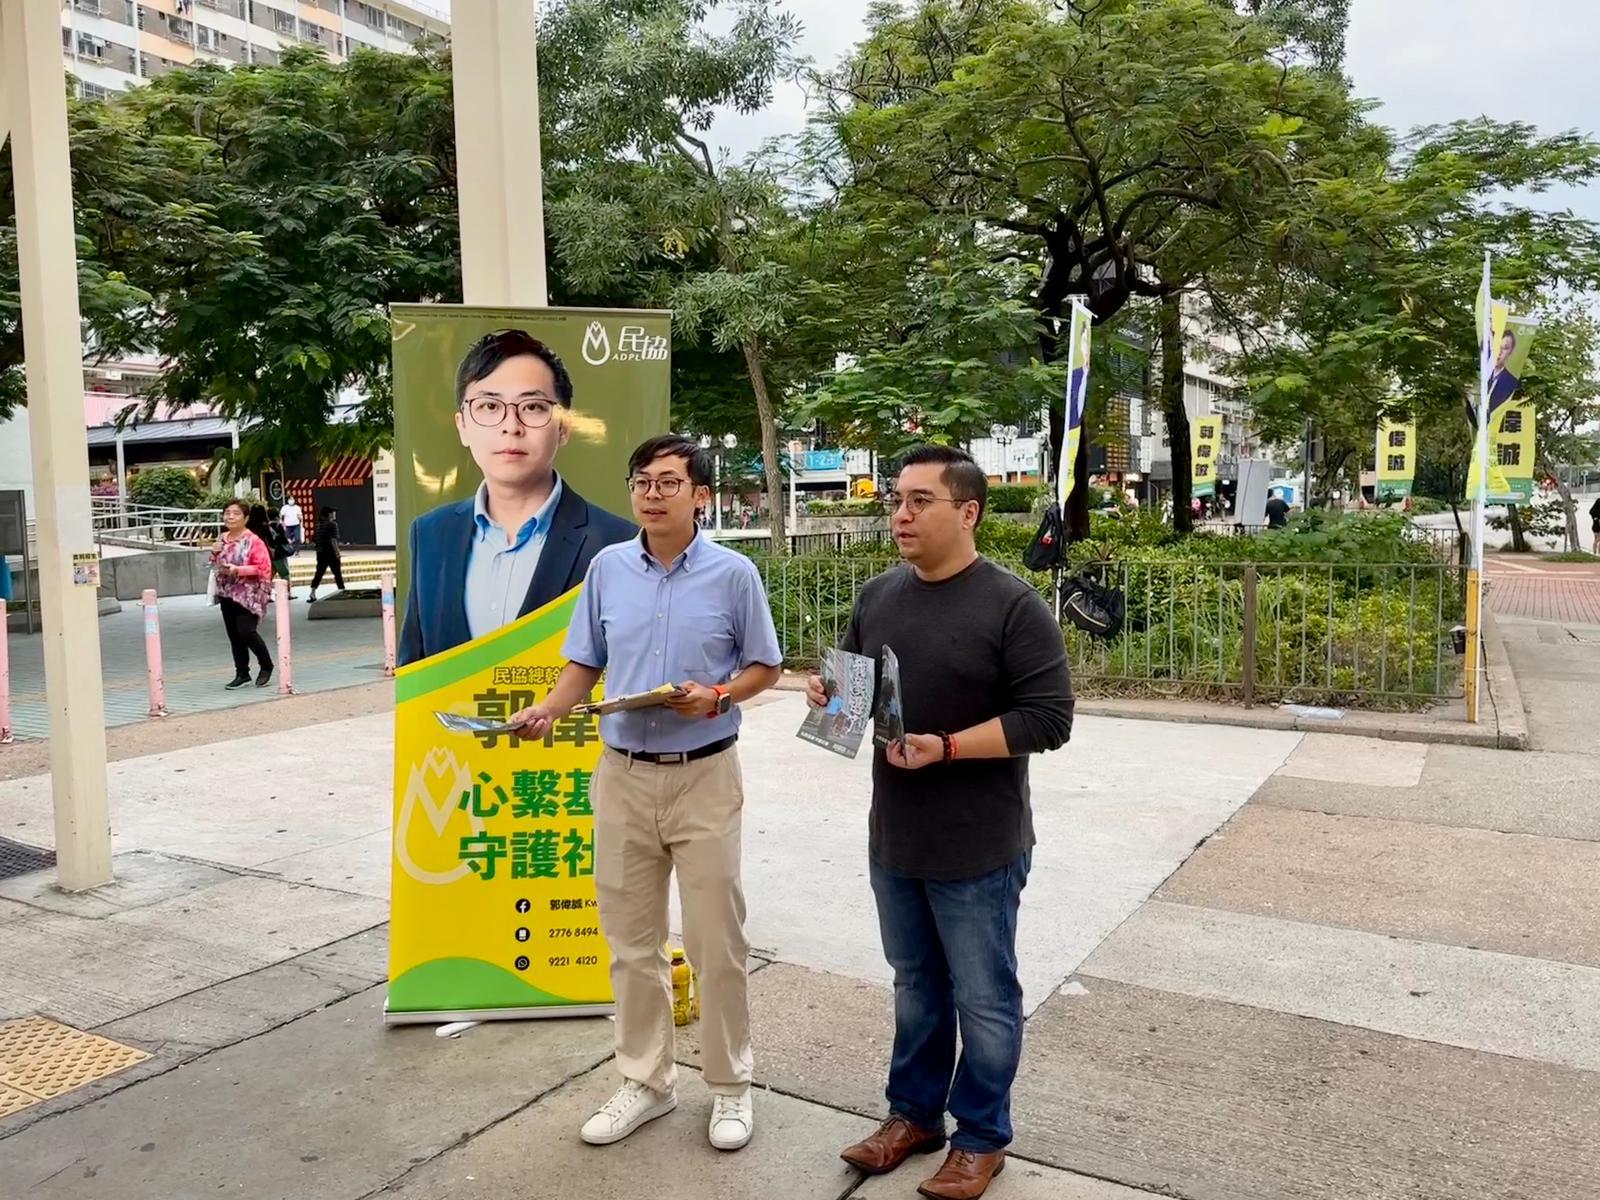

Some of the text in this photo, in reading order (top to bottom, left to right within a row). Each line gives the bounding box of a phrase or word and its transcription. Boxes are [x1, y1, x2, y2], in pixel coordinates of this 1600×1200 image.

[618, 325, 668, 360] 民協
[612, 353, 641, 361] ADPL
[493, 666, 563, 685] 民協總幹
[473, 688, 600, 749] 郭偉
[549, 926, 598, 938] 2776 8494
[548, 955, 598, 967] 9221 4120
